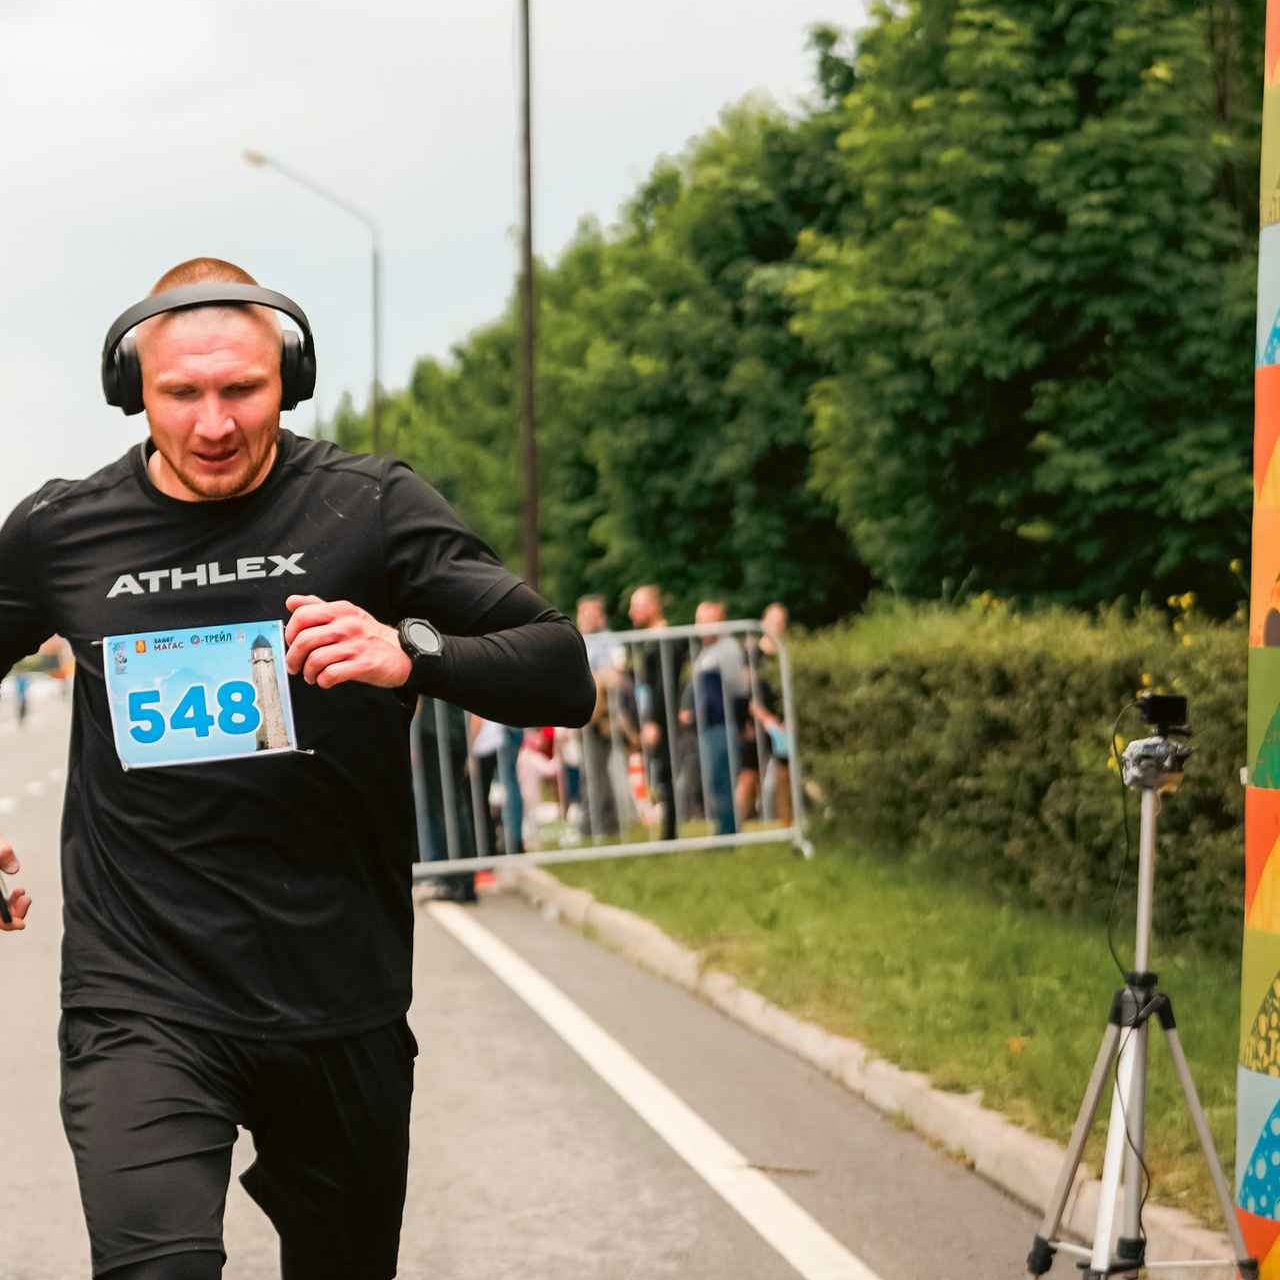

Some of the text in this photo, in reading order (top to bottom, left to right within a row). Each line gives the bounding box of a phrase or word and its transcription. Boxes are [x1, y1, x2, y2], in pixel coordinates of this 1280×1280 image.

[106, 552, 307, 598] ATHLEX
[154, 642, 184, 651] МАГАС
[128, 681, 261, 743] 548
